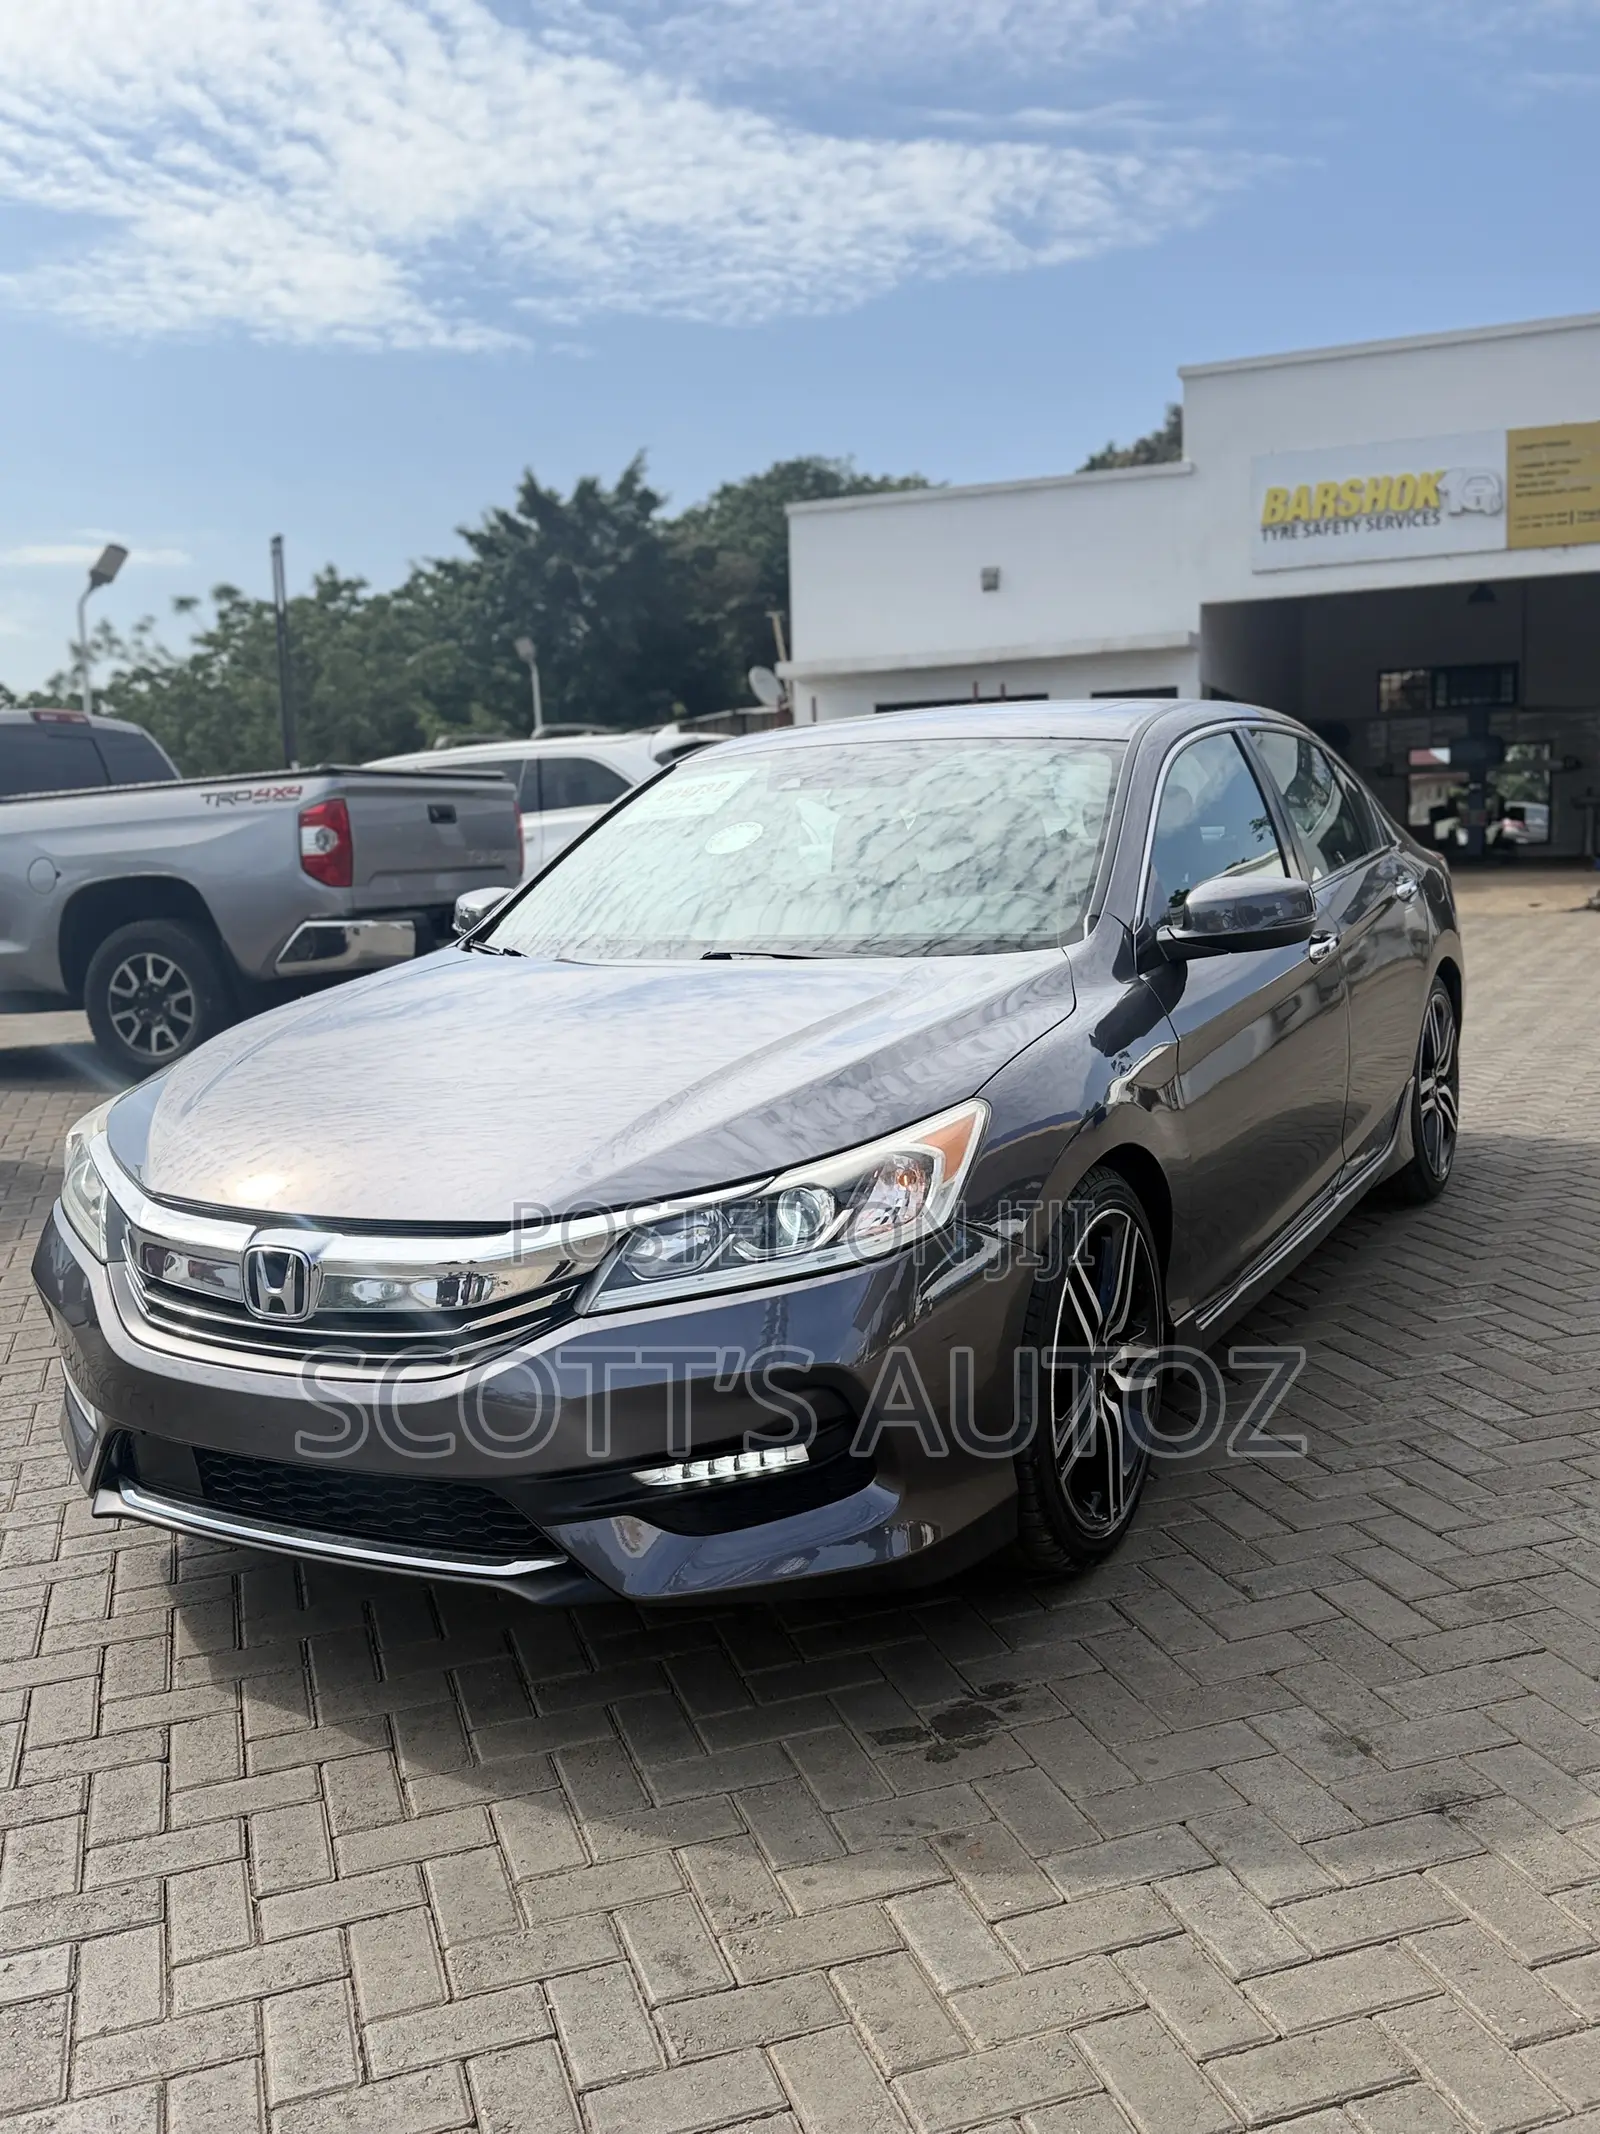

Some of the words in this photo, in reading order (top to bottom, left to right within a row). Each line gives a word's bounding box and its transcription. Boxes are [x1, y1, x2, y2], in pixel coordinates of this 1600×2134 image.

[1261, 470, 1445, 526] BARSHOK
[1261, 523, 1298, 542] TYRE
[1303, 517, 1362, 538] SAFETY
[1366, 508, 1441, 532] SERVICES
